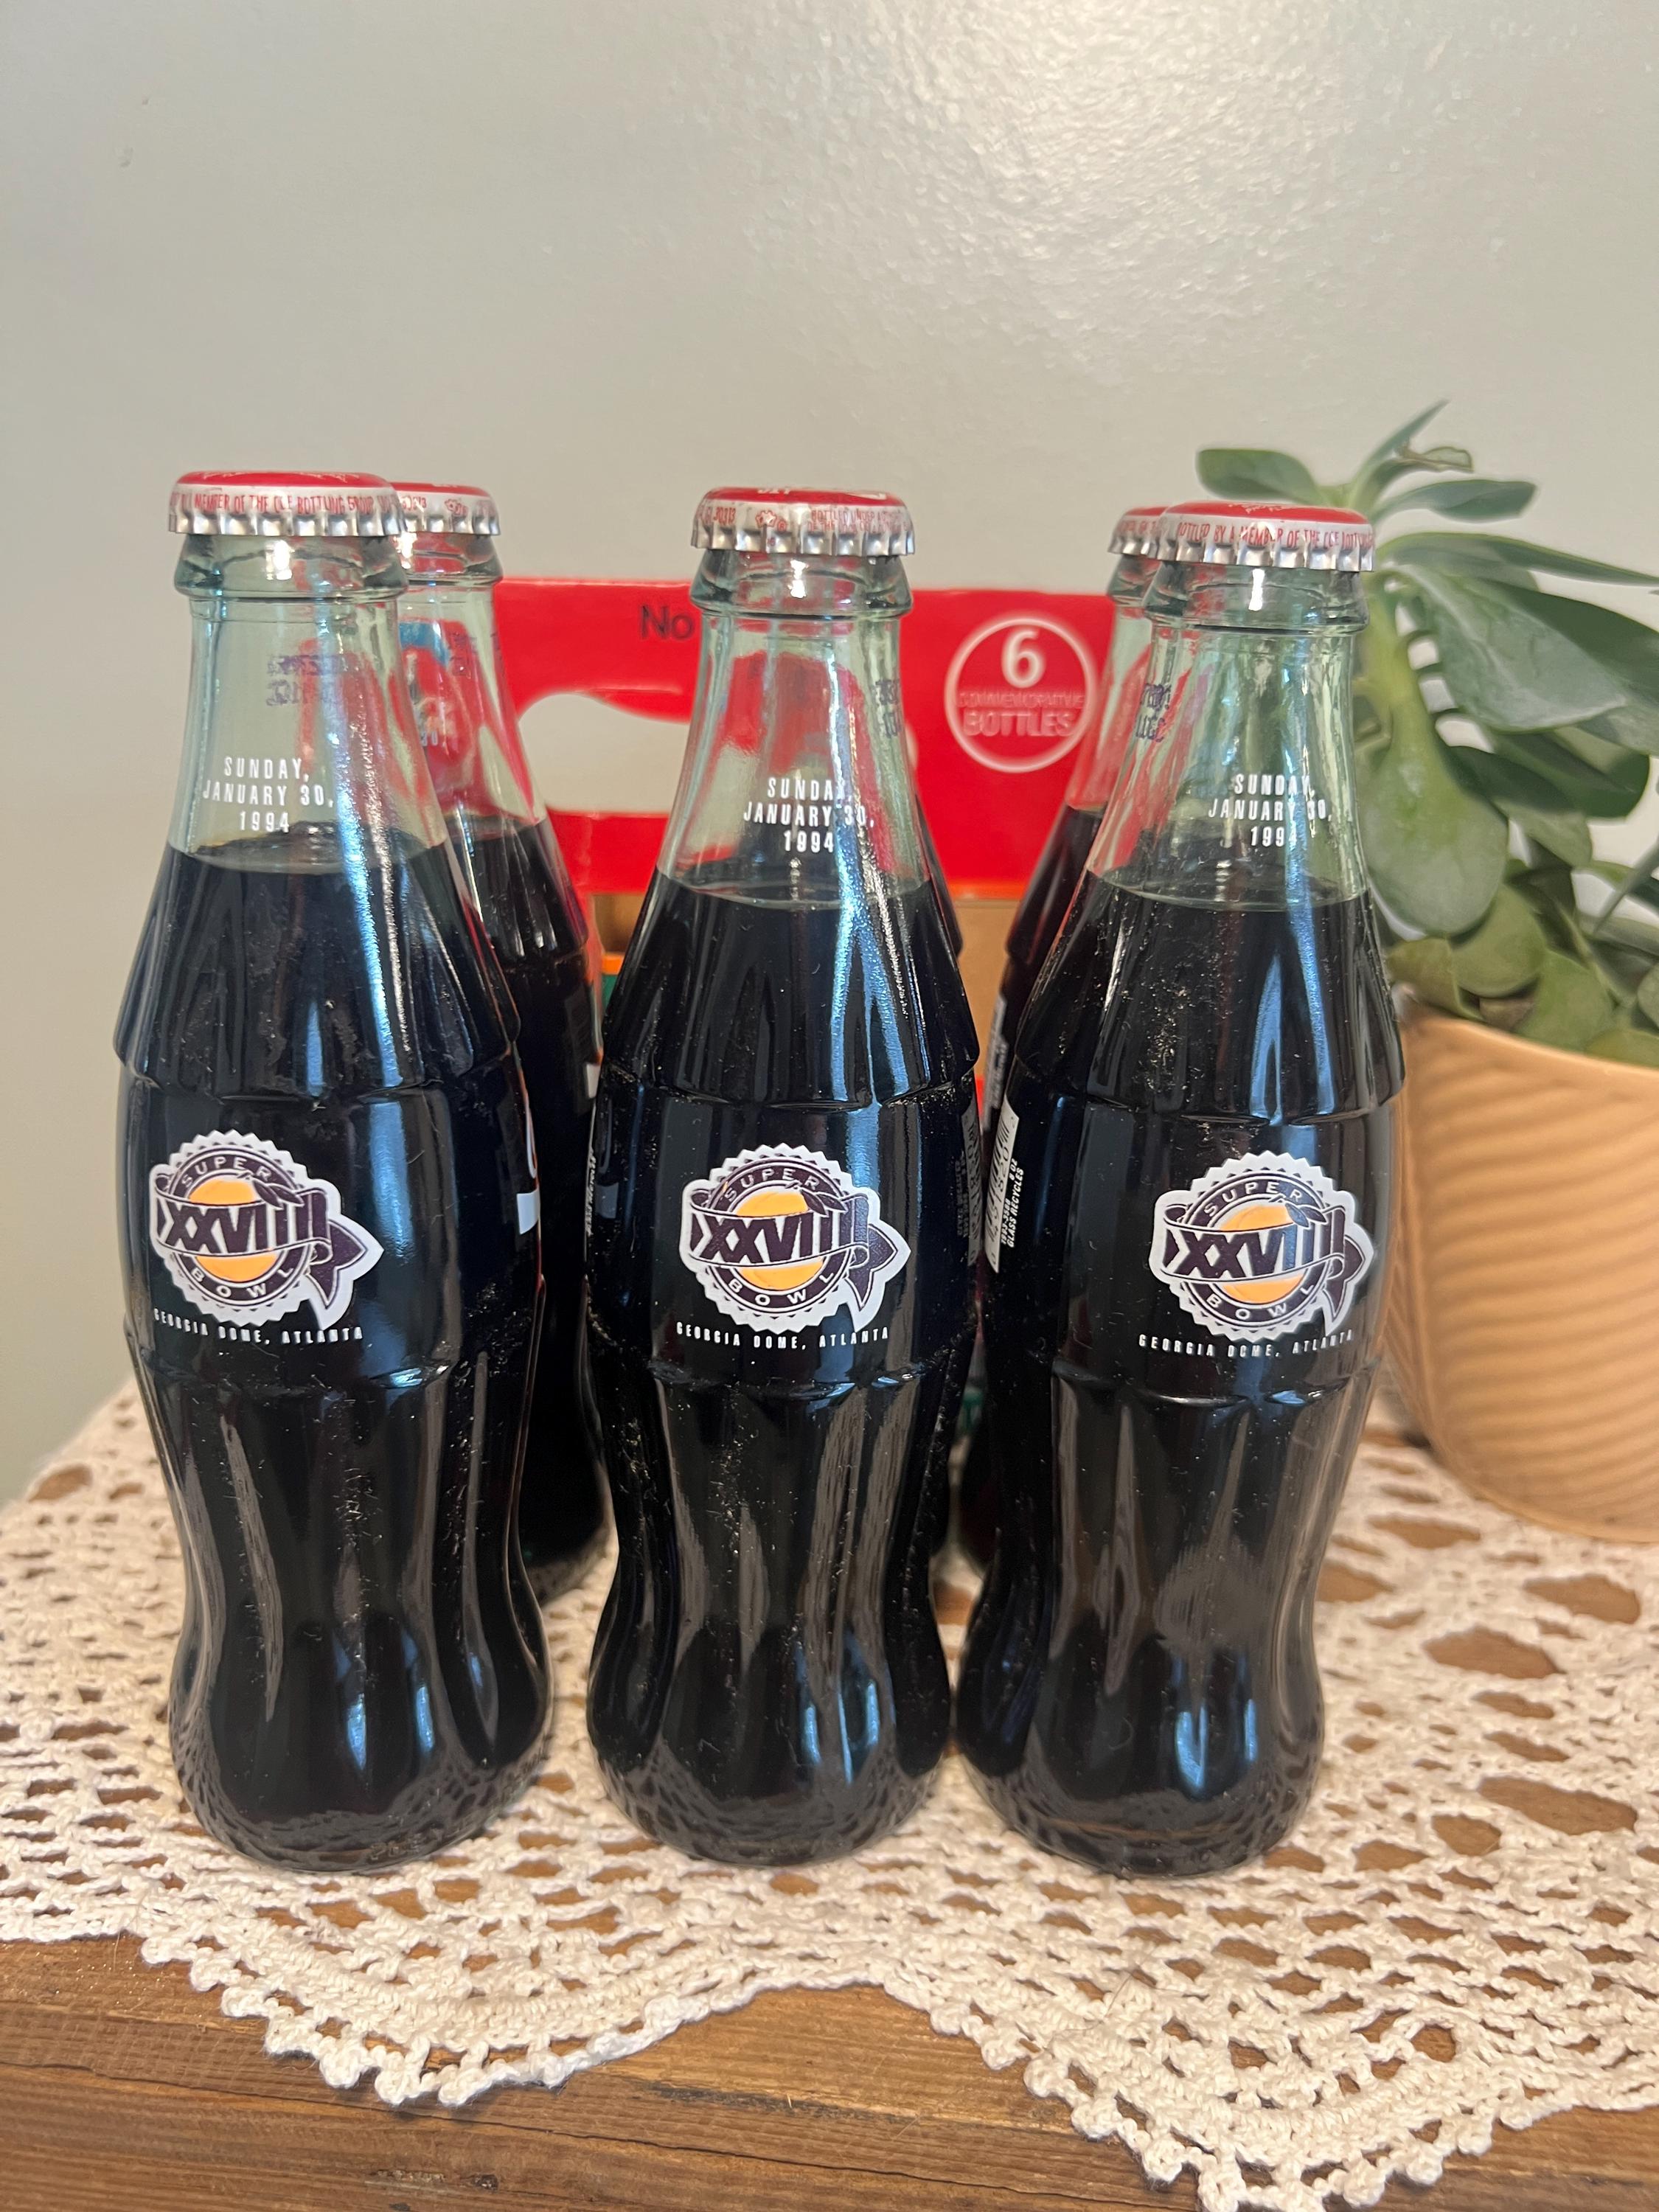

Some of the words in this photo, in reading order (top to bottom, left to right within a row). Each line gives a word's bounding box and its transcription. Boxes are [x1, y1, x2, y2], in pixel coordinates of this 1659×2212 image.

[250, 494, 268, 514] THE
[1287, 529, 1299, 549] OF
[1304, 529, 1321, 549] THE
[1001, 630, 1046, 689] 6
[964, 708, 1073, 737] BOTTLES
[223, 756, 310, 782] SUNDAY,
[202, 779, 288, 806] JANUARY
[299, 784, 334, 808] 30,
[1234, 773, 1315, 797] SUNDAY,
[240, 810, 290, 833] 1994
[743, 801, 832, 827] JANUARY
[844, 804, 875, 827] 30,
[1208, 798, 1296, 821] JANUARY
[1307, 799, 1332, 822] 30,
[783, 831, 835, 853] 1994
[1250, 826, 1298, 847] 1994
[182, 1156, 272, 1189] SUPER
[725, 1168, 820, 1203] SUPER
[1010, 1167, 1024, 1217] RECYCLES
[1203, 1180, 1304, 1217] SUPER
[1006, 1216, 1017, 1248] GLASS
[191, 1266, 294, 1298] BOWL
[729, 1272, 835, 1306] BOWL
[1206, 1283, 1315, 1320] BOWL
[153, 1308, 209, 1336] GEORGIA
[218, 1326, 271, 1345] DOME,
[282, 1326, 364, 1344] ATLANTA
[676, 1321, 741, 1346] GEORGIA
[754, 1335, 806, 1351] DOME,
[819, 1326, 888, 1347] ATLANTA
[1138, 1333, 1215, 1357] GEORGIA
[1227, 1344, 1281, 1357] DOME,
[1292, 1329, 1353, 1354] ATLANTA
